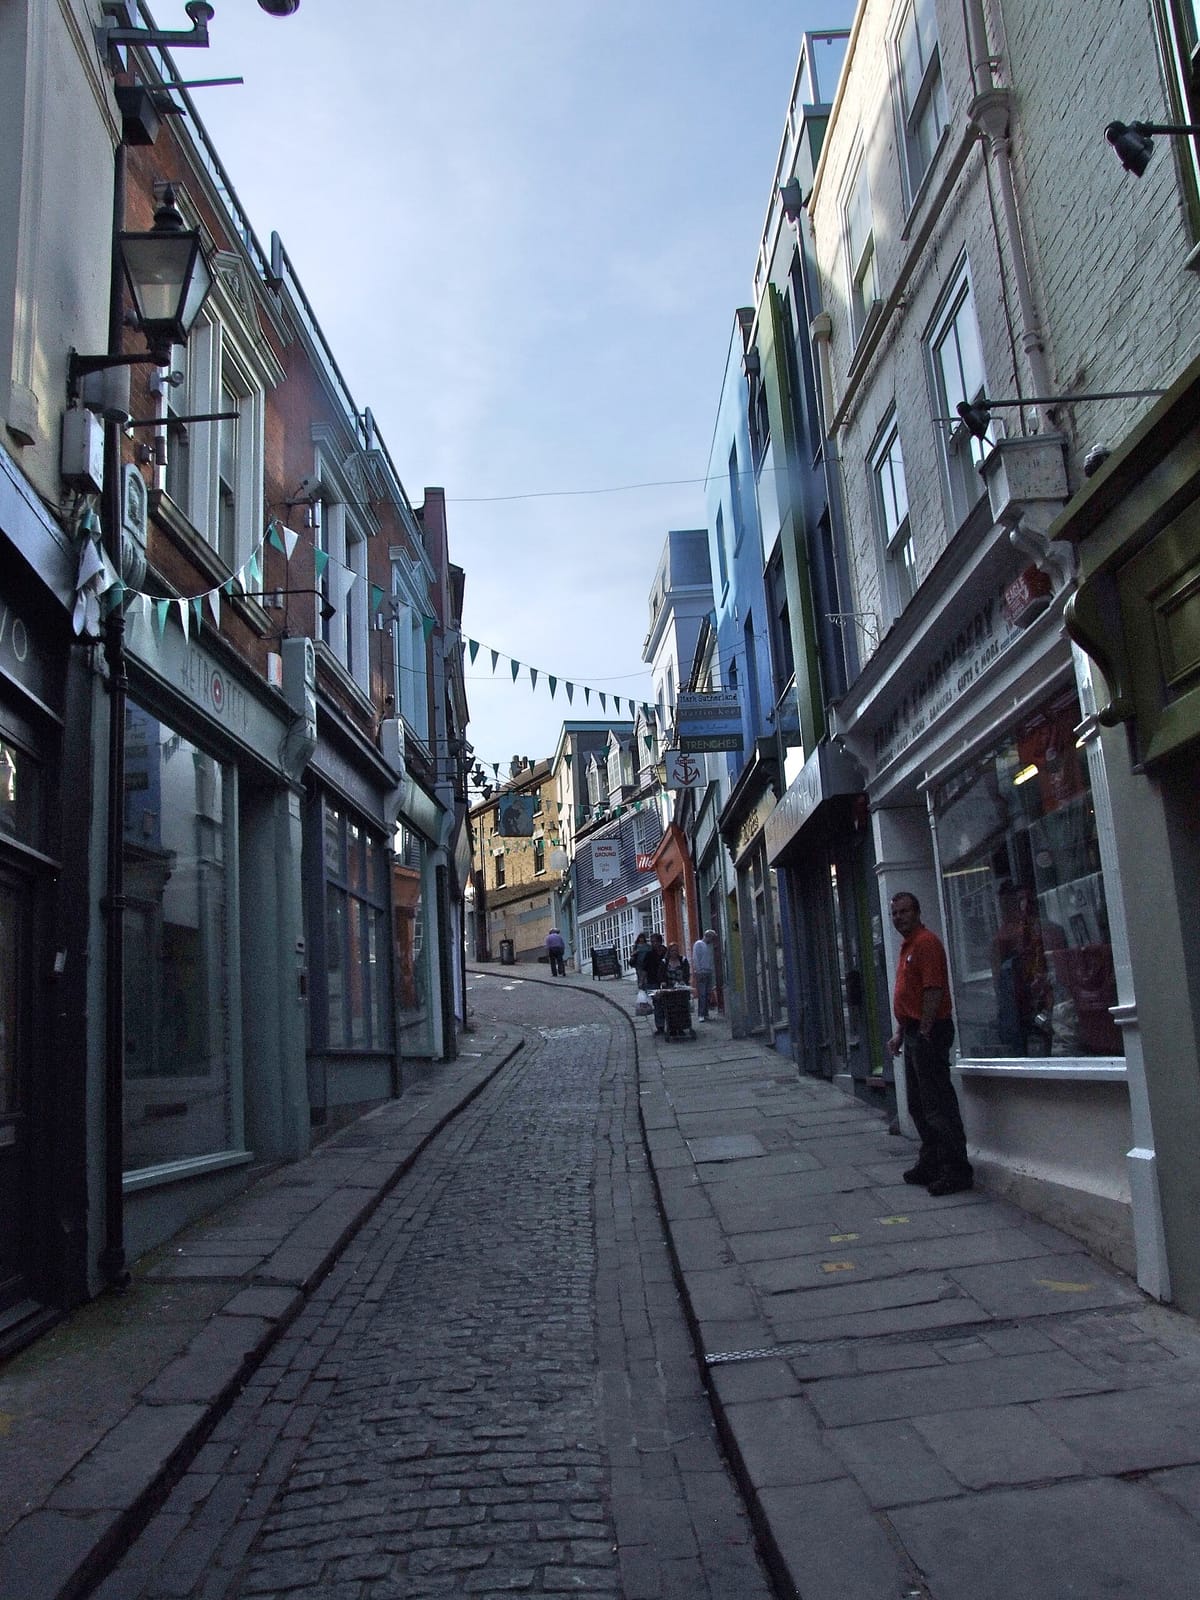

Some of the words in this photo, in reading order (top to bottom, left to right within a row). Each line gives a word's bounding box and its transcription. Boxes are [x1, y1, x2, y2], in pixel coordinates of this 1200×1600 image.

[957, 667, 973, 692] GIFTS
[981, 639, 999, 670] MORE
[685, 739, 738, 751] TRENCHES
